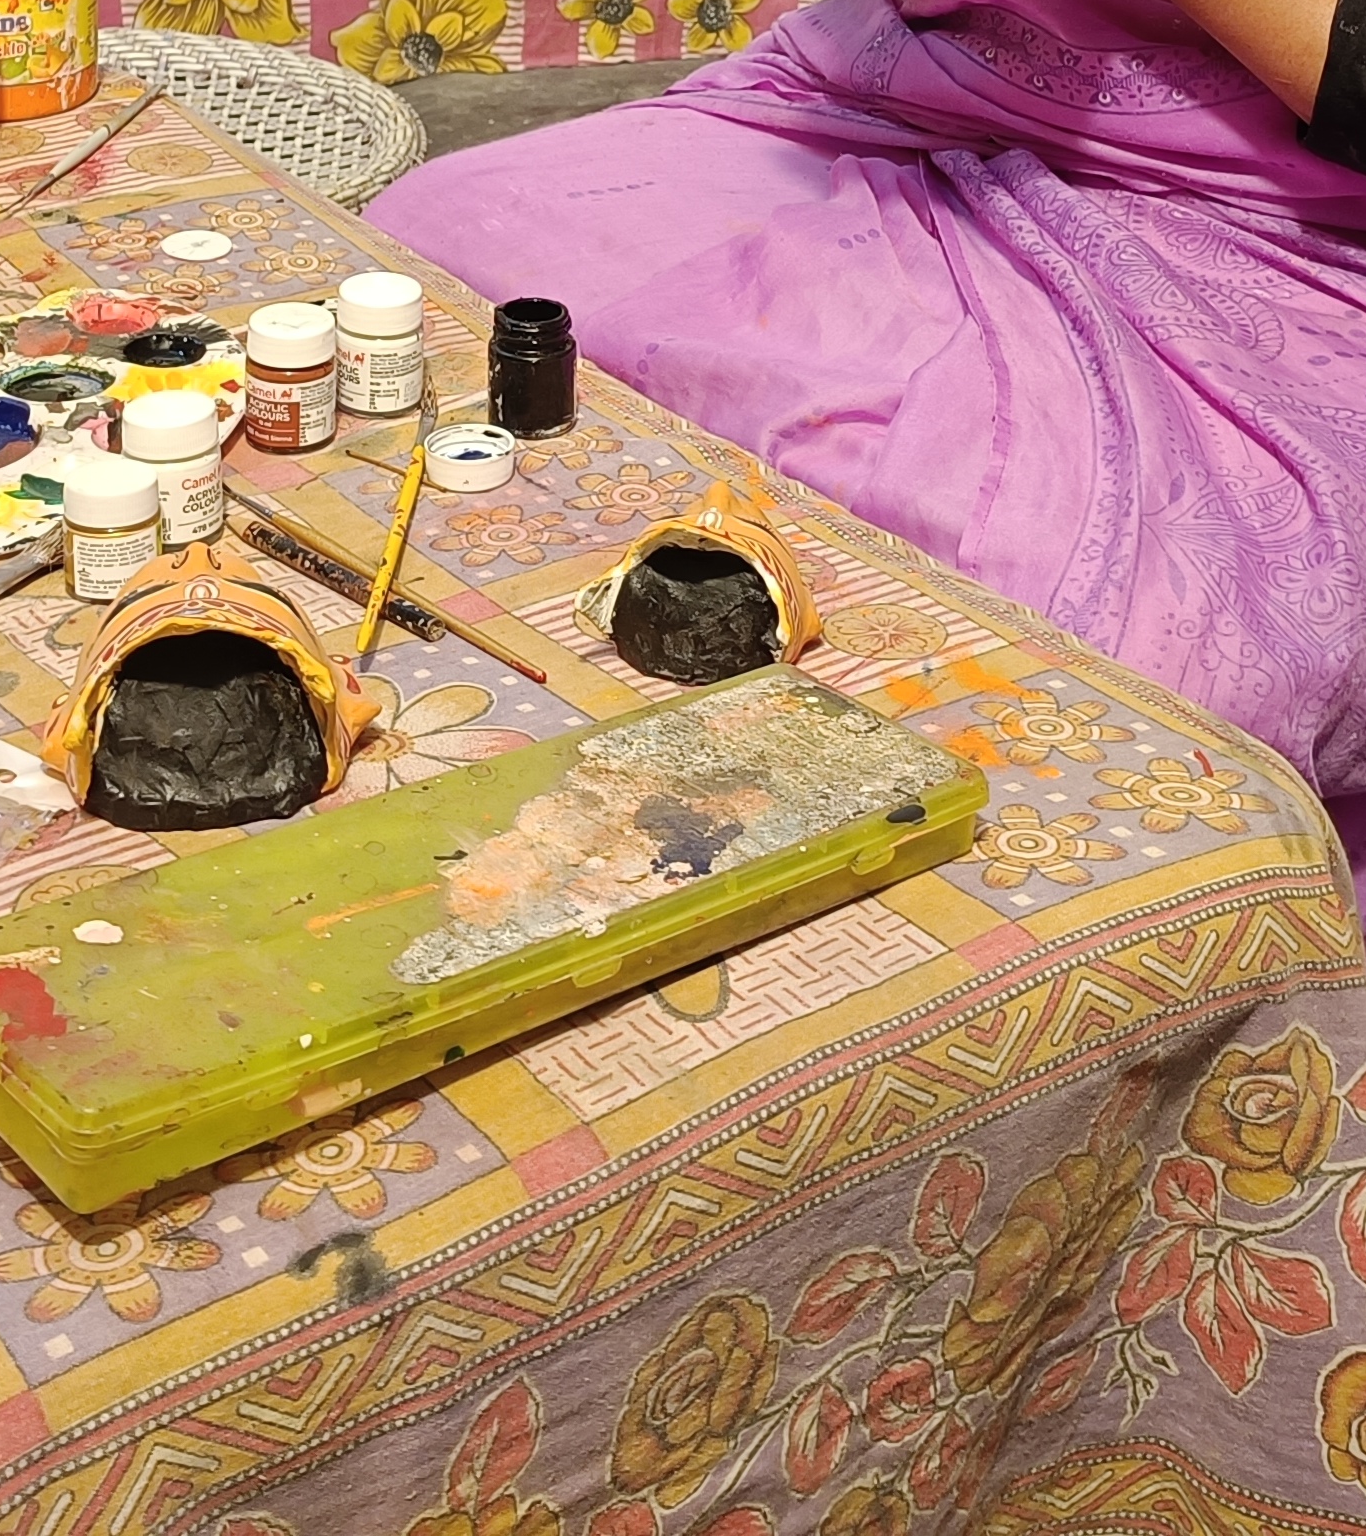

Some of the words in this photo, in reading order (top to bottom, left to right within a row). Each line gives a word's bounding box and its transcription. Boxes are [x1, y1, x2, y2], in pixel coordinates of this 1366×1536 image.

[246, 380, 276, 400] Camel
[248, 404, 290, 421] COLOURS
[249, 397, 289, 413] ACRYLIC
[182, 467, 217, 490] Camel
